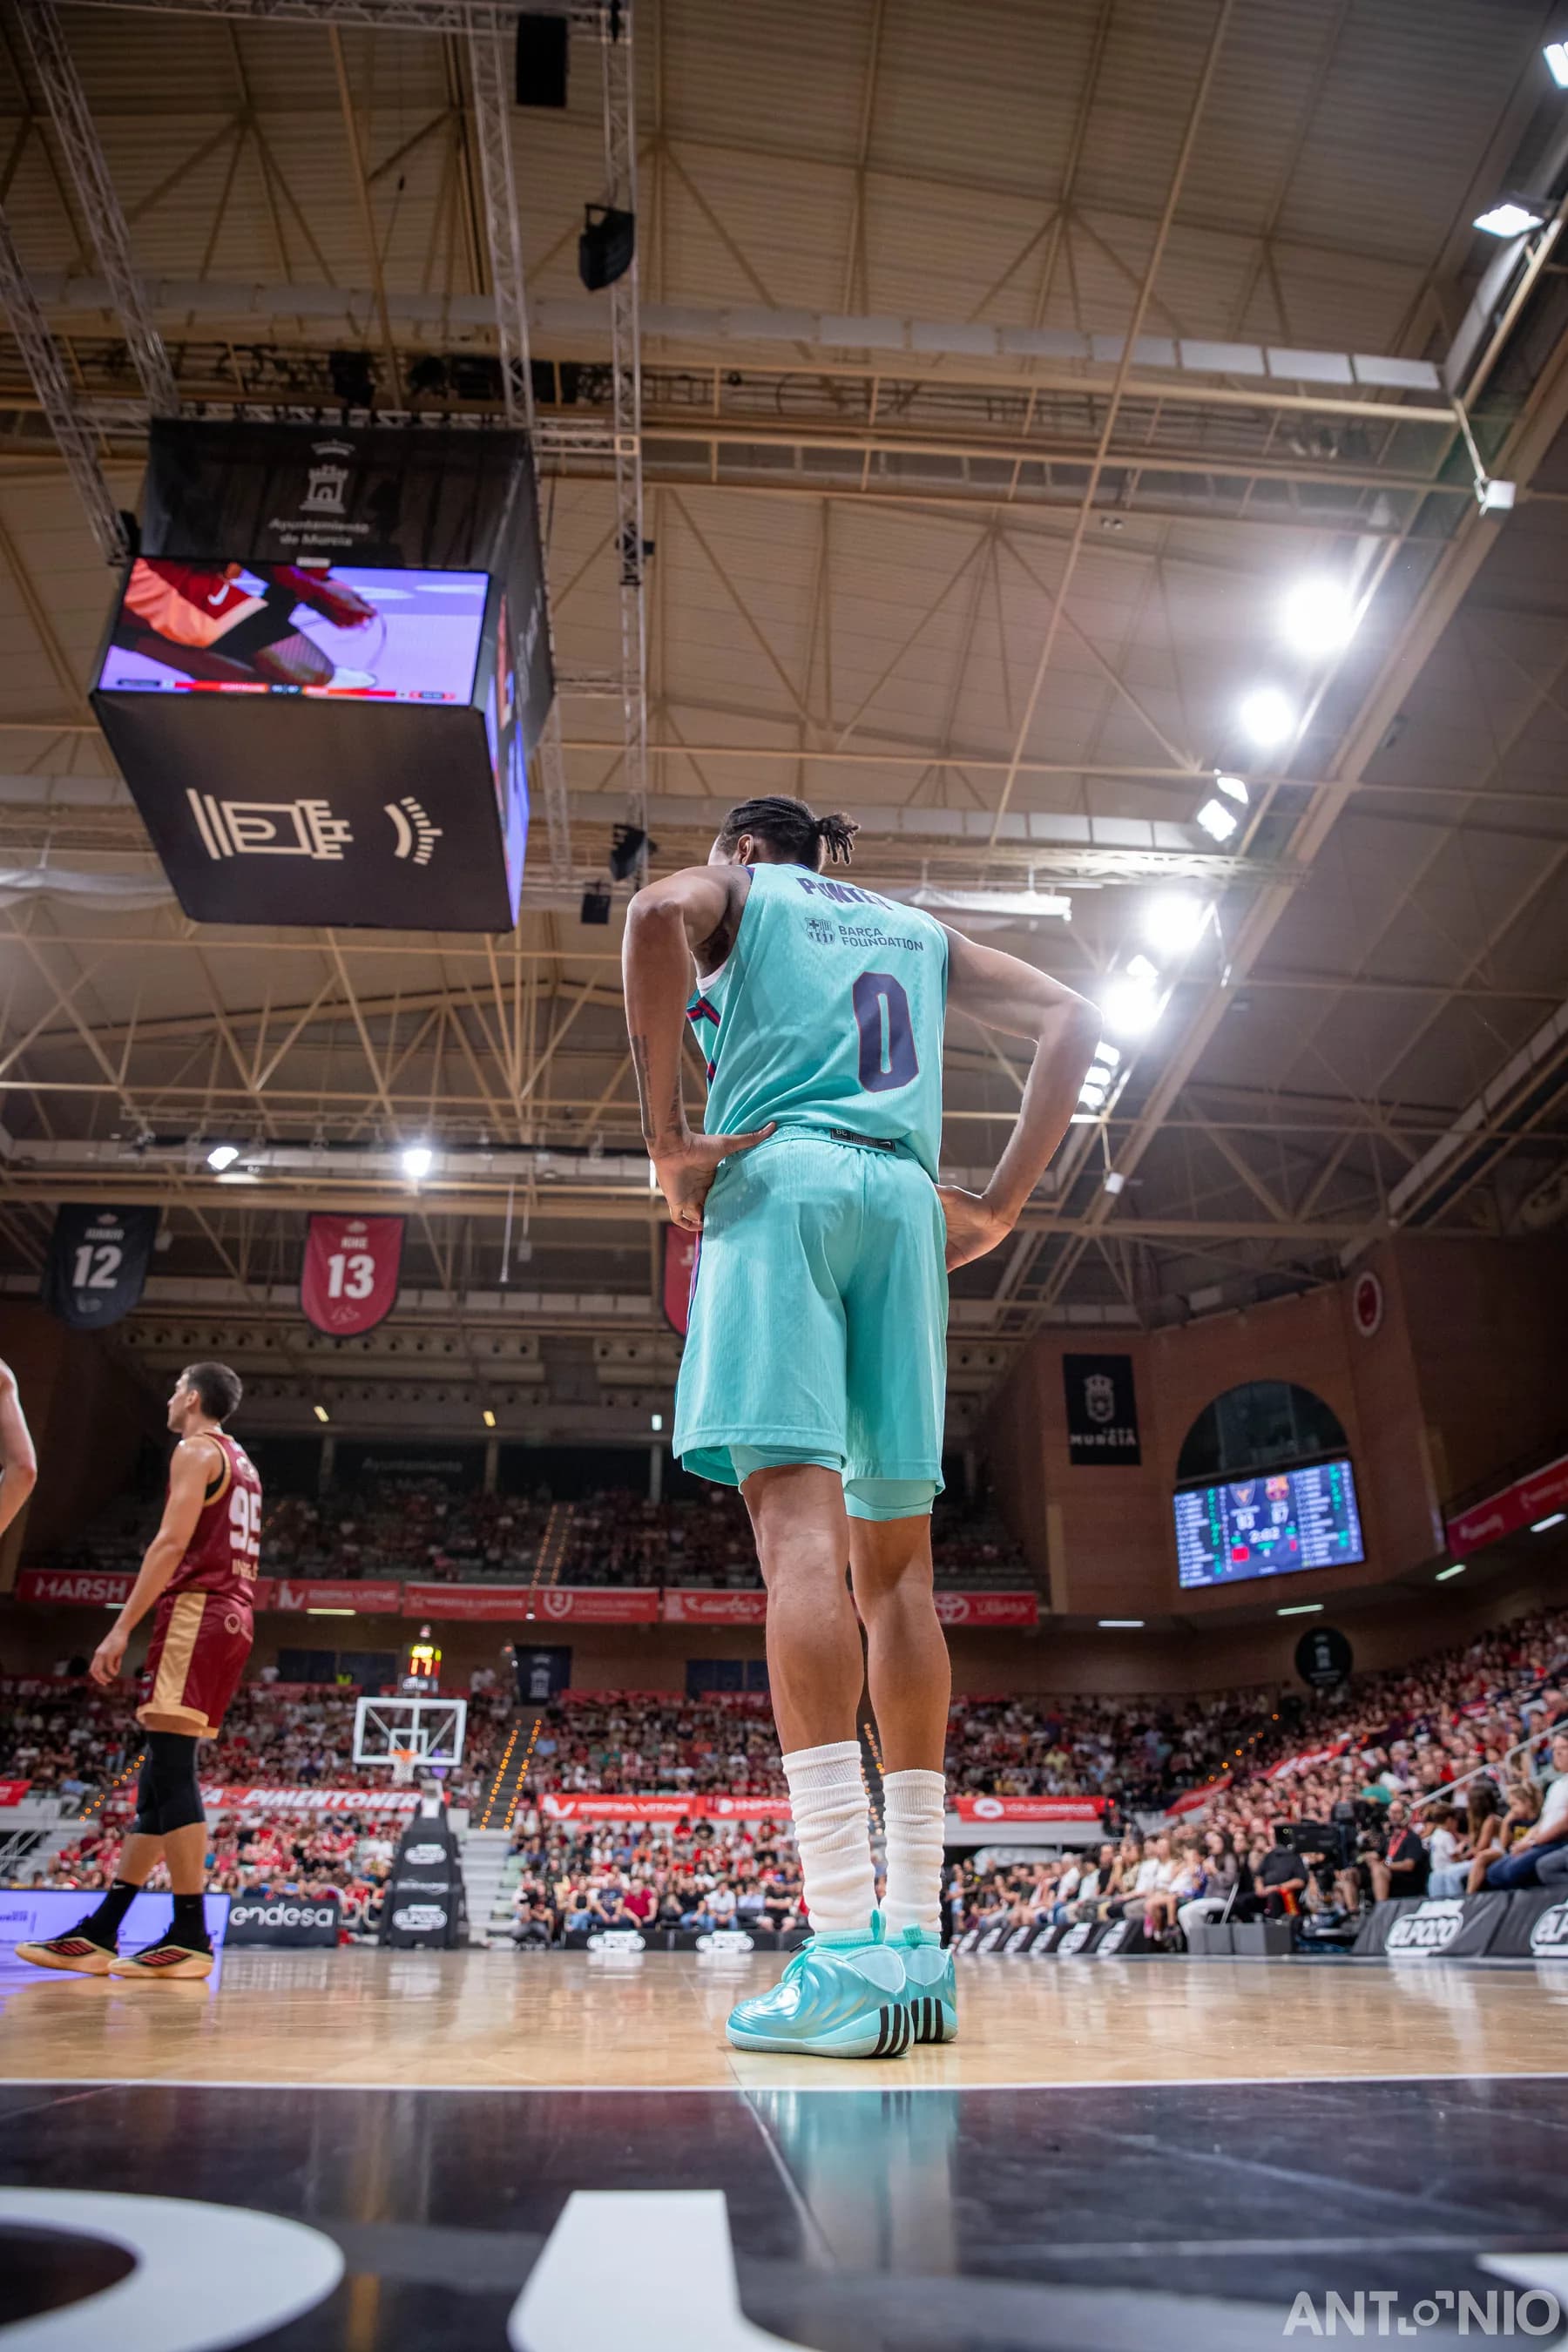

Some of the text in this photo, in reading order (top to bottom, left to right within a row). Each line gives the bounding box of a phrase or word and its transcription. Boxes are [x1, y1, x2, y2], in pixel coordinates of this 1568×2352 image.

[838, 925, 883, 938] BARÇA
[841, 936, 924, 951] FOUNDATION
[852, 971, 919, 1093] 0
[72, 1245, 123, 1288] 12
[328, 1254, 376, 1300] 13
[228, 1485, 262, 1557] 95
[34, 1577, 127, 1601] MARSH
[410, 1658, 433, 1677] 17
[229, 1903, 335, 1928] endesa
